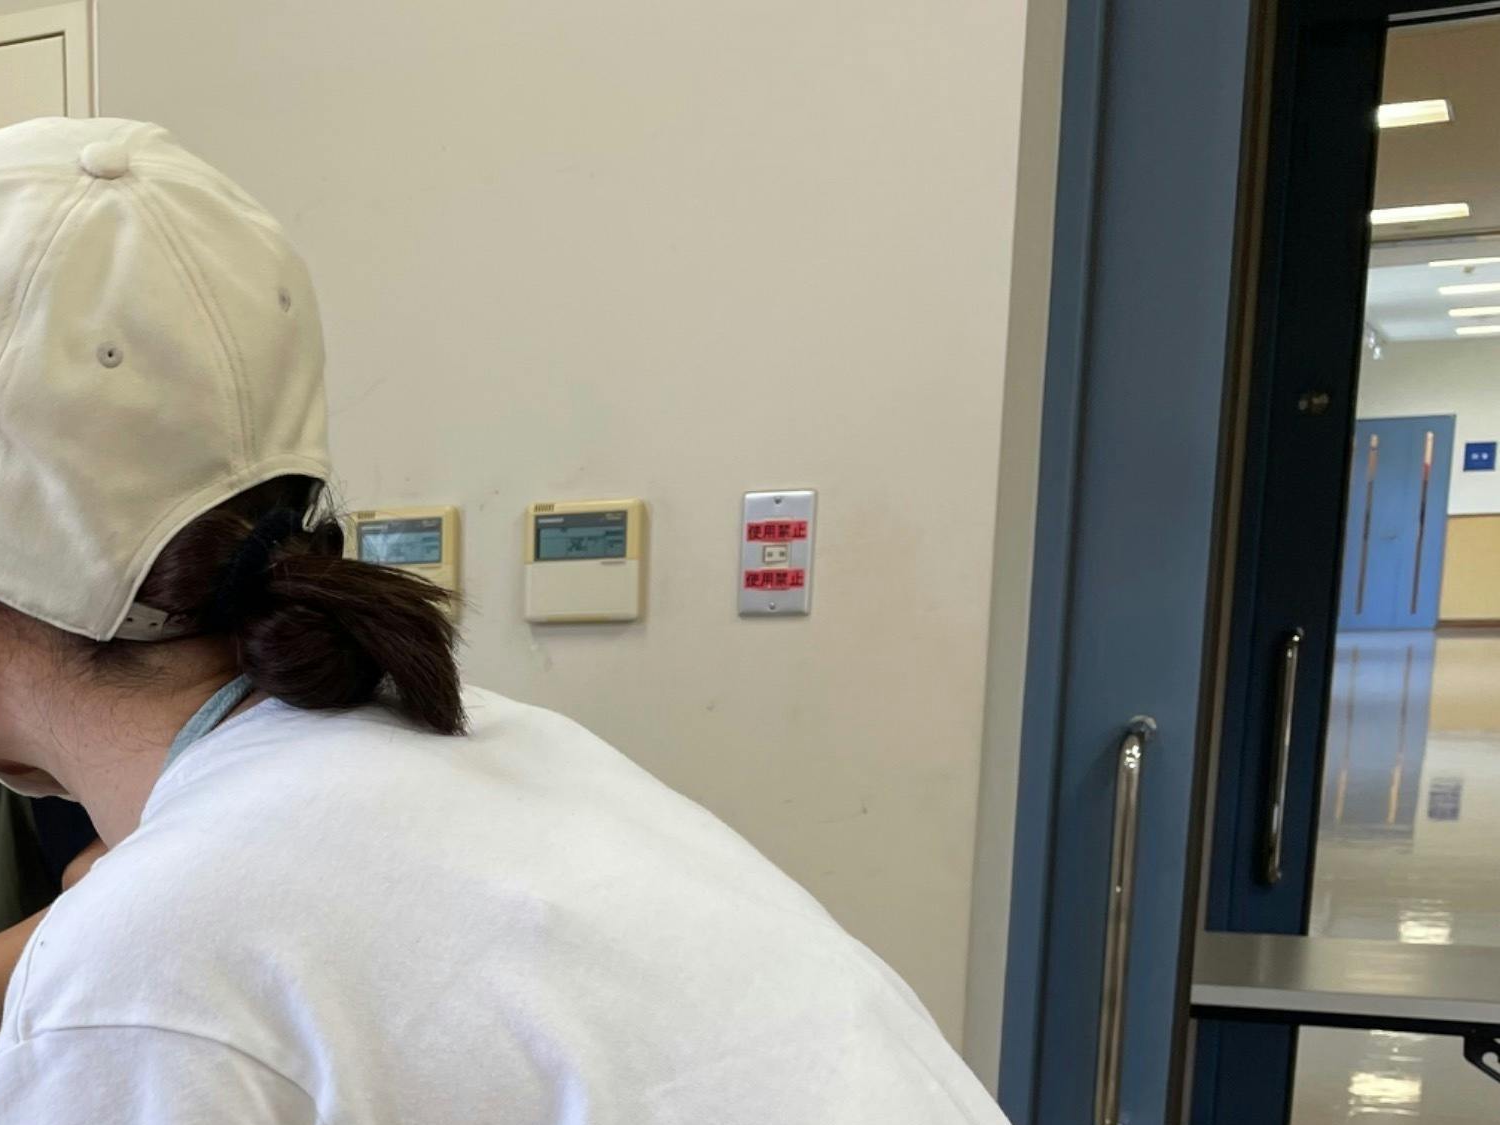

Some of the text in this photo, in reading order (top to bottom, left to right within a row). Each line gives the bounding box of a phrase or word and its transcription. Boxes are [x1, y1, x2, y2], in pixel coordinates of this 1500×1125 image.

[747, 523, 807, 540] 使用禁止
[745, 570, 804, 588] 使用禁止
